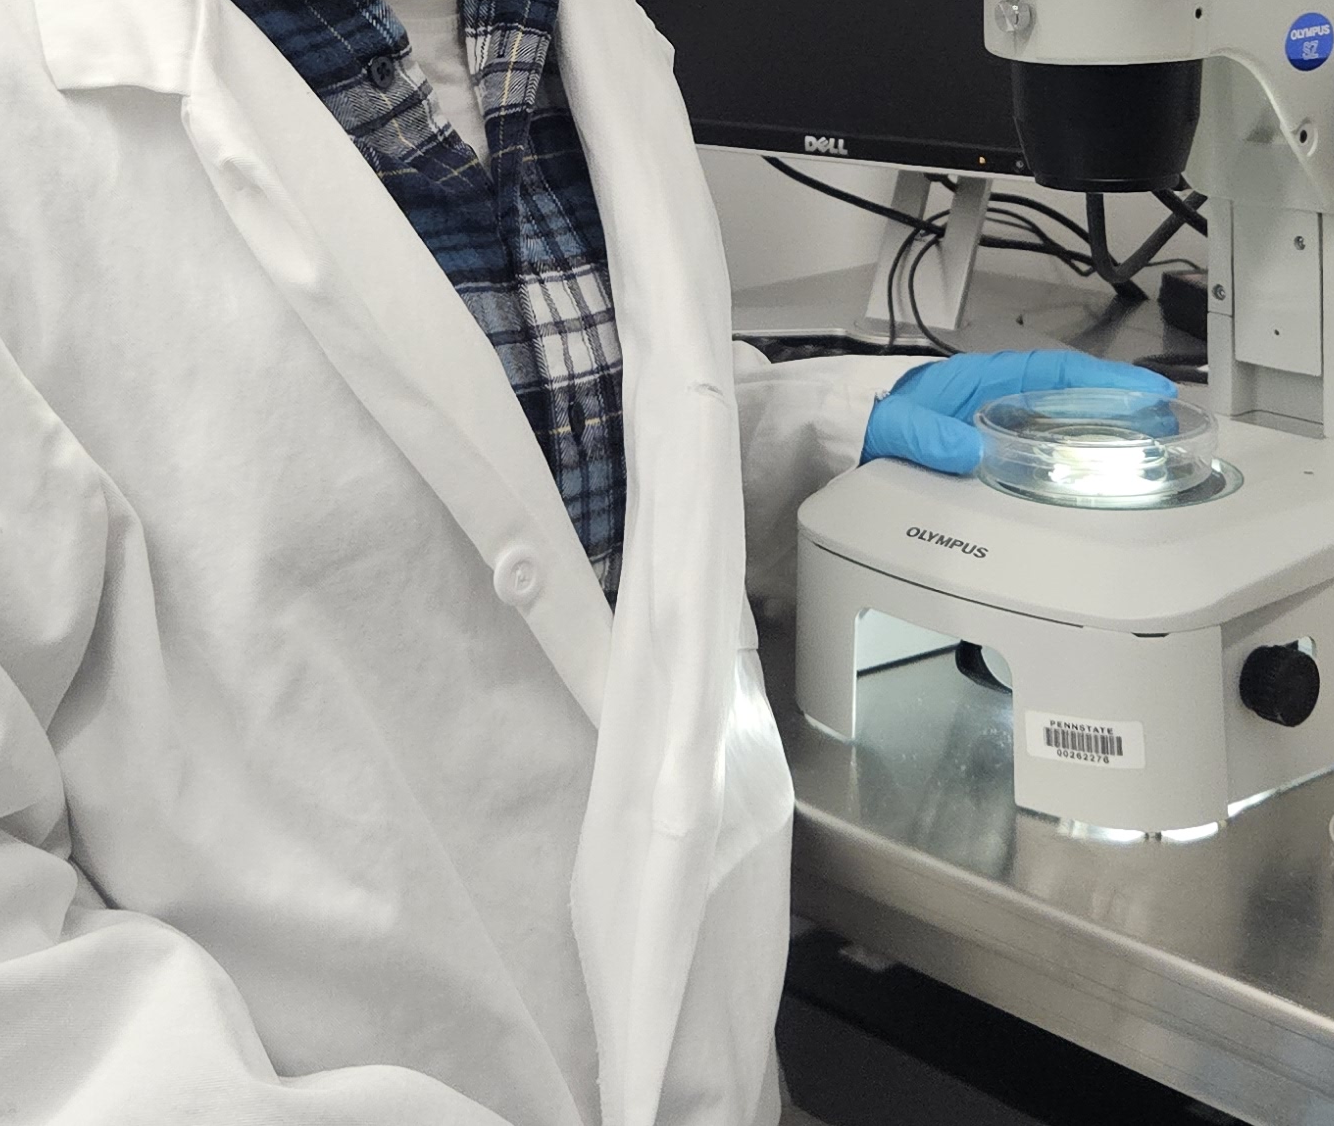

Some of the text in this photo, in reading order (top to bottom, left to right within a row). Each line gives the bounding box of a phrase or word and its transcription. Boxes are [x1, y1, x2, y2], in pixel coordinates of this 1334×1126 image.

[1290, 24, 1331, 41] OLYMPUS
[804, 135, 849, 155] DELL
[906, 526, 990, 560] OLYMPUS
[1049, 719, 1114, 735] PENNSTATE
